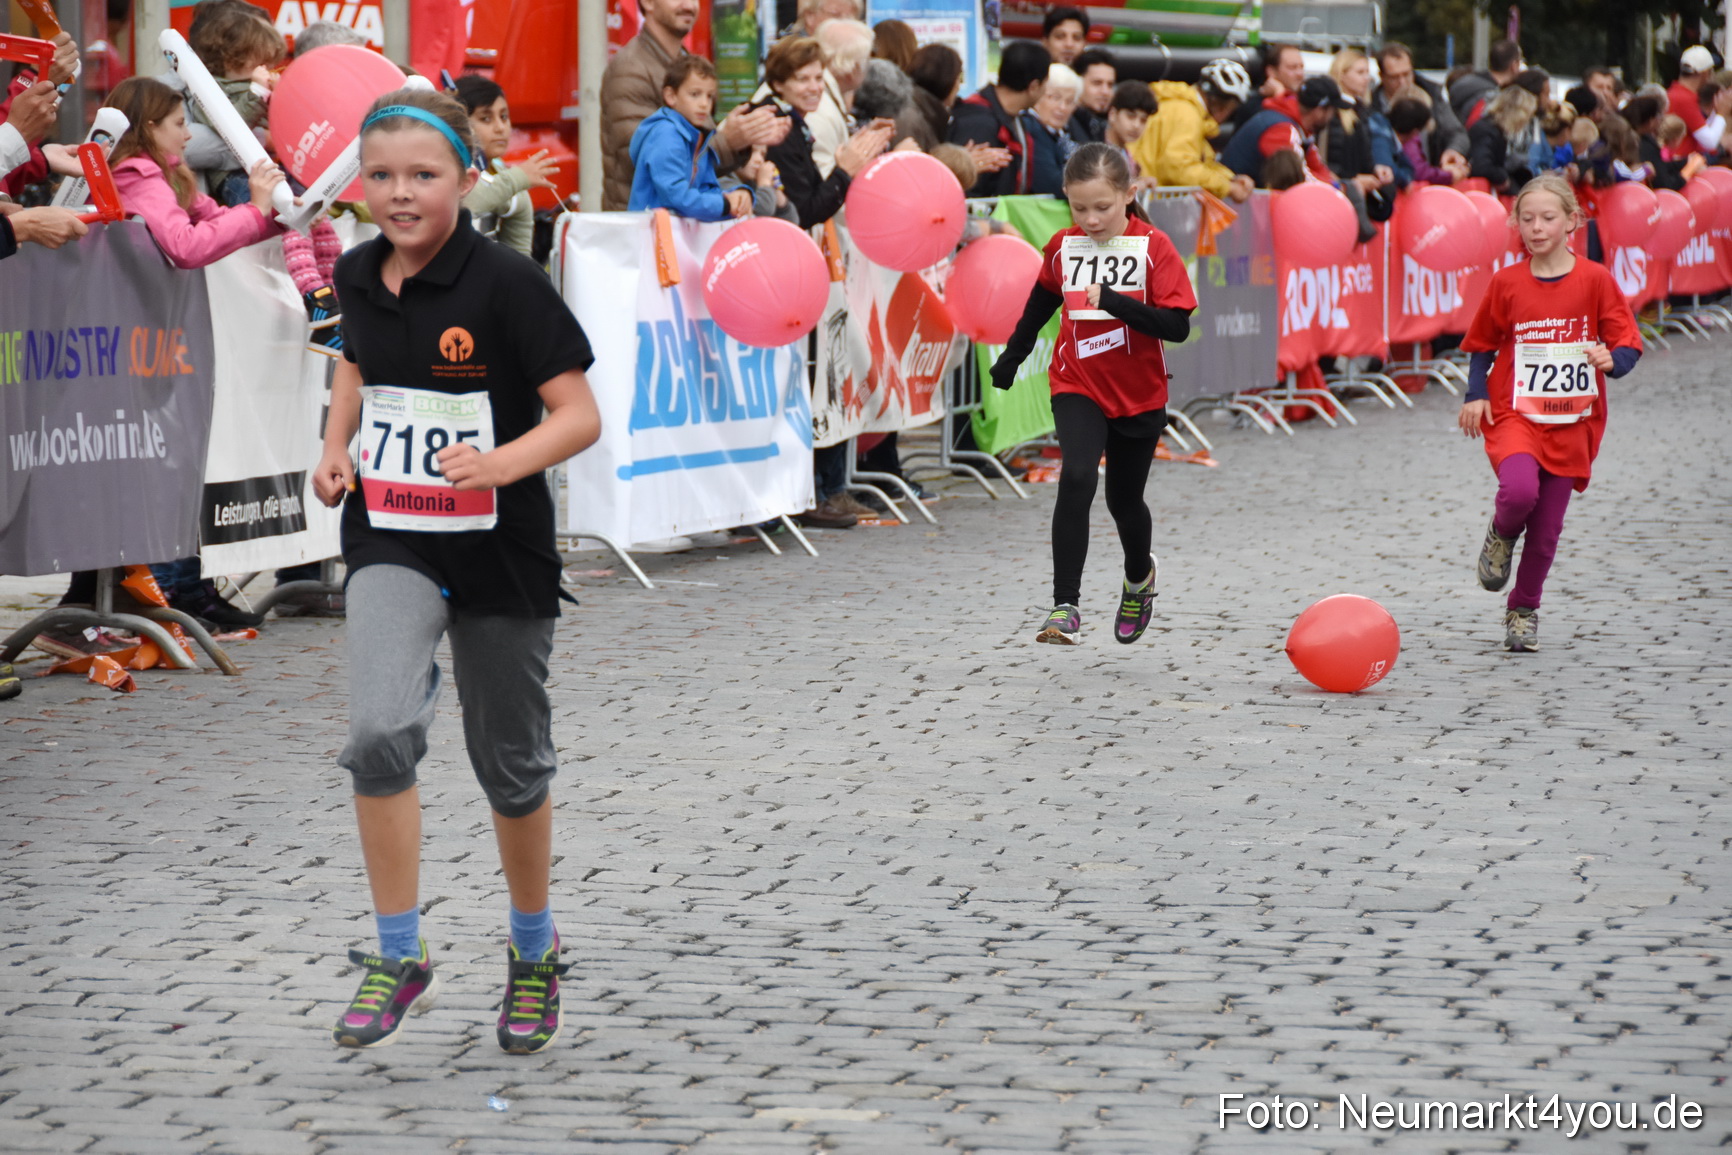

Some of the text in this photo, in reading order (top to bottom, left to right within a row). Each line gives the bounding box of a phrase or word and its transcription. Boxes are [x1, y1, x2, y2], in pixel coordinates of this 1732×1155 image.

[273, 0, 384, 47] AVIA
[1068, 256, 1138, 286] 7132
[1515, 317, 1567, 331] Neumarkter
[1089, 338, 1112, 351] DEHN
[1515, 328, 1556, 344] Stadtlauf
[1524, 362, 1590, 393] 7236
[1543, 400, 1574, 412] Heidi
[383, 488, 456, 512] Antonia
